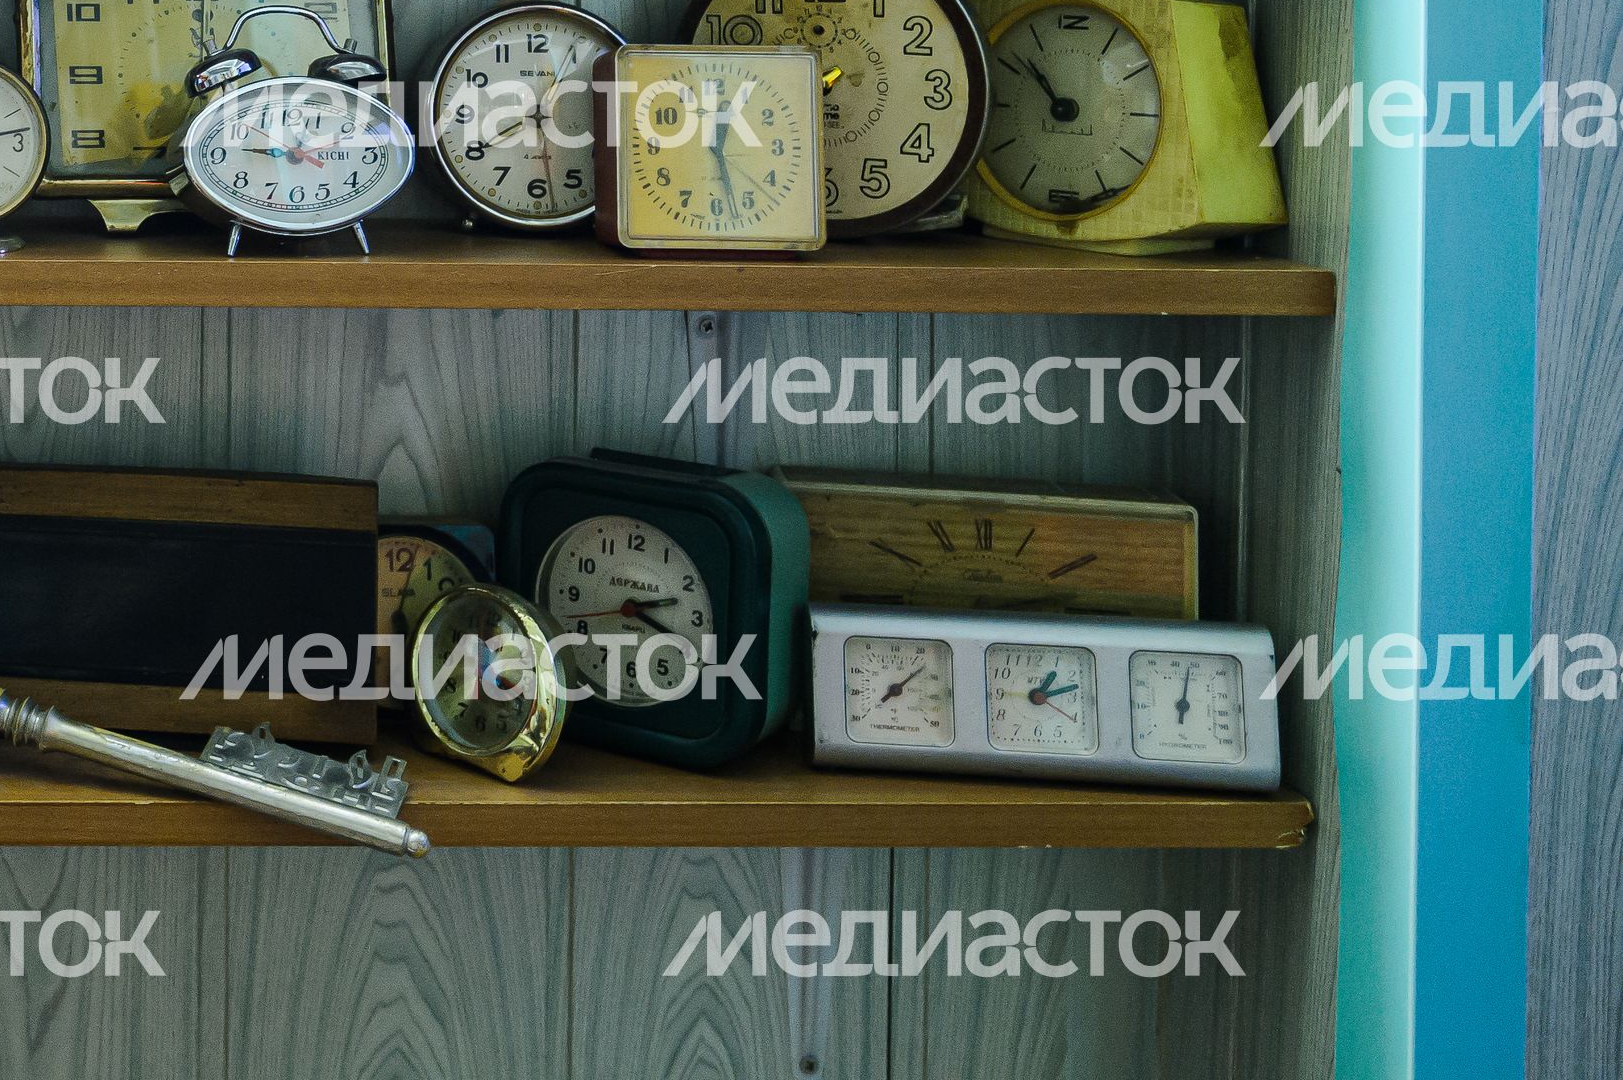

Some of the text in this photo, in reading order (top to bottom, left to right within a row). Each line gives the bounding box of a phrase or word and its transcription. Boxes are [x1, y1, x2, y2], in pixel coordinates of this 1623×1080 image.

[67, 3, 100, 22] 10
[526, 34, 548, 53] 12
[904, 16, 933, 56] 2
[70, 66, 103, 84] 9
[924, 69, 952, 110] 3
[900, 123, 934, 162] 4
[210, 147, 227, 165] 9
[318, 151, 349, 161] KICHI
[361, 147, 378, 165] 3
[564, 169, 583, 189] 5
[628, 534, 645, 552] 12
[385, 548, 414, 571] 12
[578, 557, 596, 574] 10
[682, 575, 695, 592] 2
